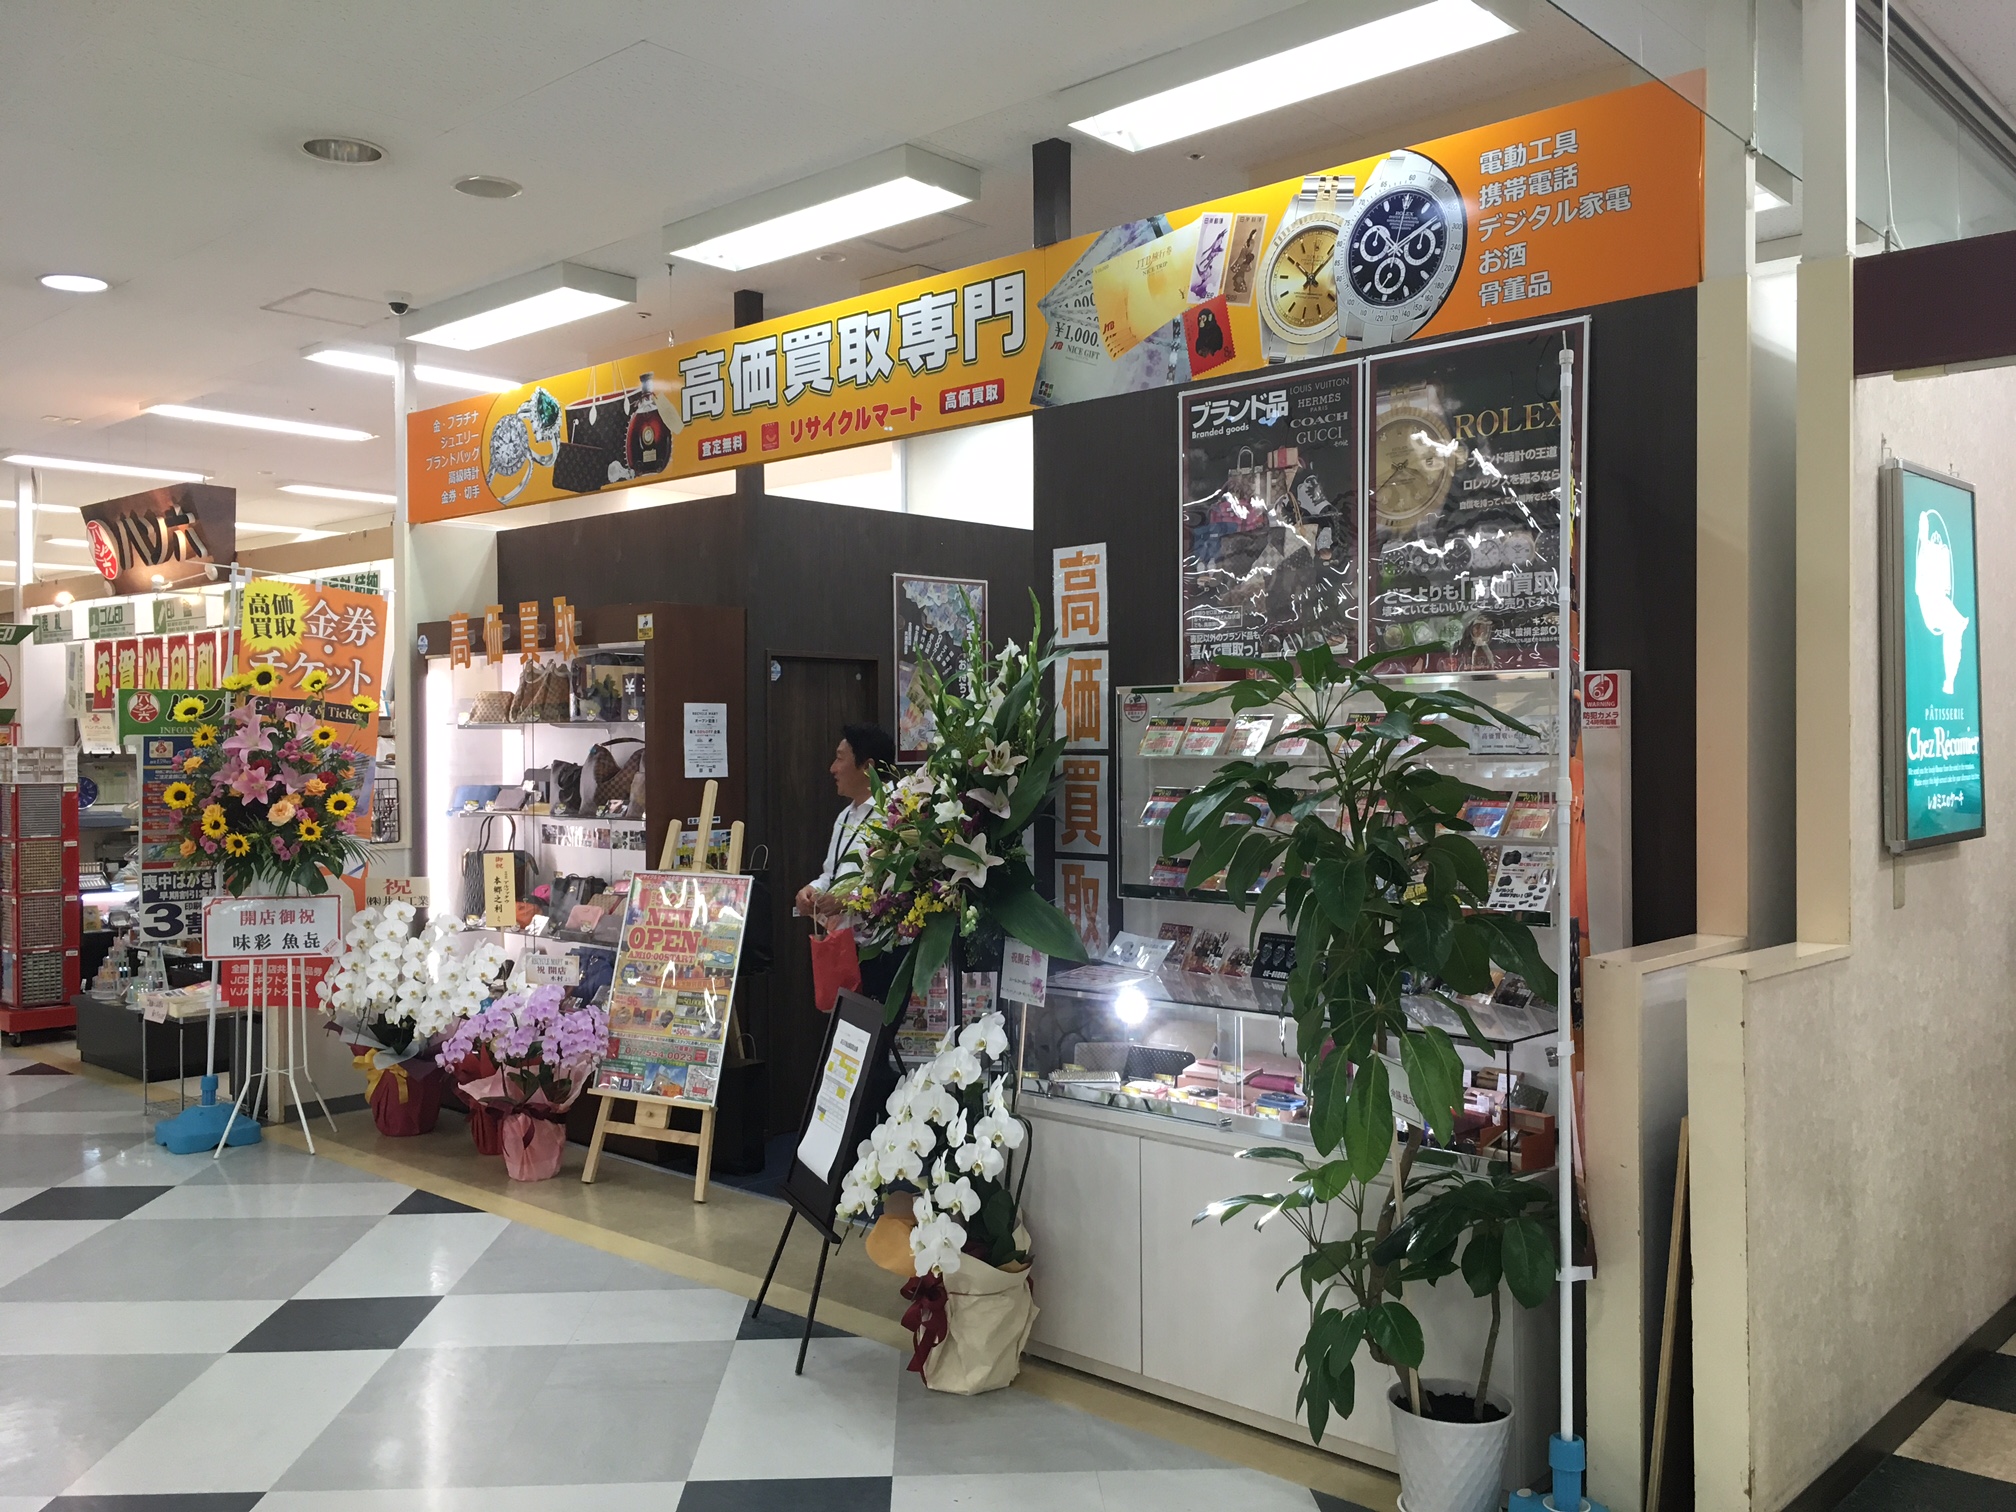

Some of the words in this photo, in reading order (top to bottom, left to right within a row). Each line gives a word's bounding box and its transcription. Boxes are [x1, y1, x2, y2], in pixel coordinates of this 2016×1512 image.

[1479, 129, 1578, 175] 電動工具
[1479, 163, 1578, 210] 携帯電話
[1477, 184, 1632, 242] デジタル家電
[1478, 241, 1528, 275] お酒
[1478, 270, 1552, 307] 骨董品
[679, 270, 1027, 425] 高価買取専門
[1066, 344, 1083, 356] NICE
[944, 384, 999, 410] 高価買取
[1289, 383, 1312, 395] LOUIS
[1315, 377, 1350, 391] VUITTON
[789, 396, 922, 443] リサイクルマート
[1191, 389, 1289, 429] ブランド品
[1289, 411, 1348, 428] COACH
[1309, 404, 1328, 412] PARIS
[433, 410, 479, 433] 金・プラチナ
[1191, 425, 1224, 440] Branded
[1225, 423, 1250, 436] goods
[1453, 400, 1562, 441] ROLEX
[440, 430, 479, 449] ジュエリー
[701, 434, 743, 457] 査定無料
[1296, 426, 1342, 445] GUCCI
[448, 466, 480, 484] 高級時計
[441, 484, 480, 504] 金券・切手
[100, 604, 124, 625] ゴム印
[248, 592, 295, 616] 高価
[250, 616, 297, 640] 買取
[448, 596, 579, 671] 高価買取
[250, 649, 371, 696] チケット
[328, 706, 361, 720] Ticke
[1583, 711, 1619, 720] 防犯カメラ
[1925, 703, 1965, 721] PÂTISSERIE
[1059, 549, 1103, 950] 高価買取
[1907, 727, 1935, 761] Chez
[382, 878, 413, 896] 祝
[239, 908, 316, 927] 開店御祝
[232, 933, 272, 951] 味彩
[628, 927, 702, 954] OPEN
[547, 966, 567, 976] 開店
